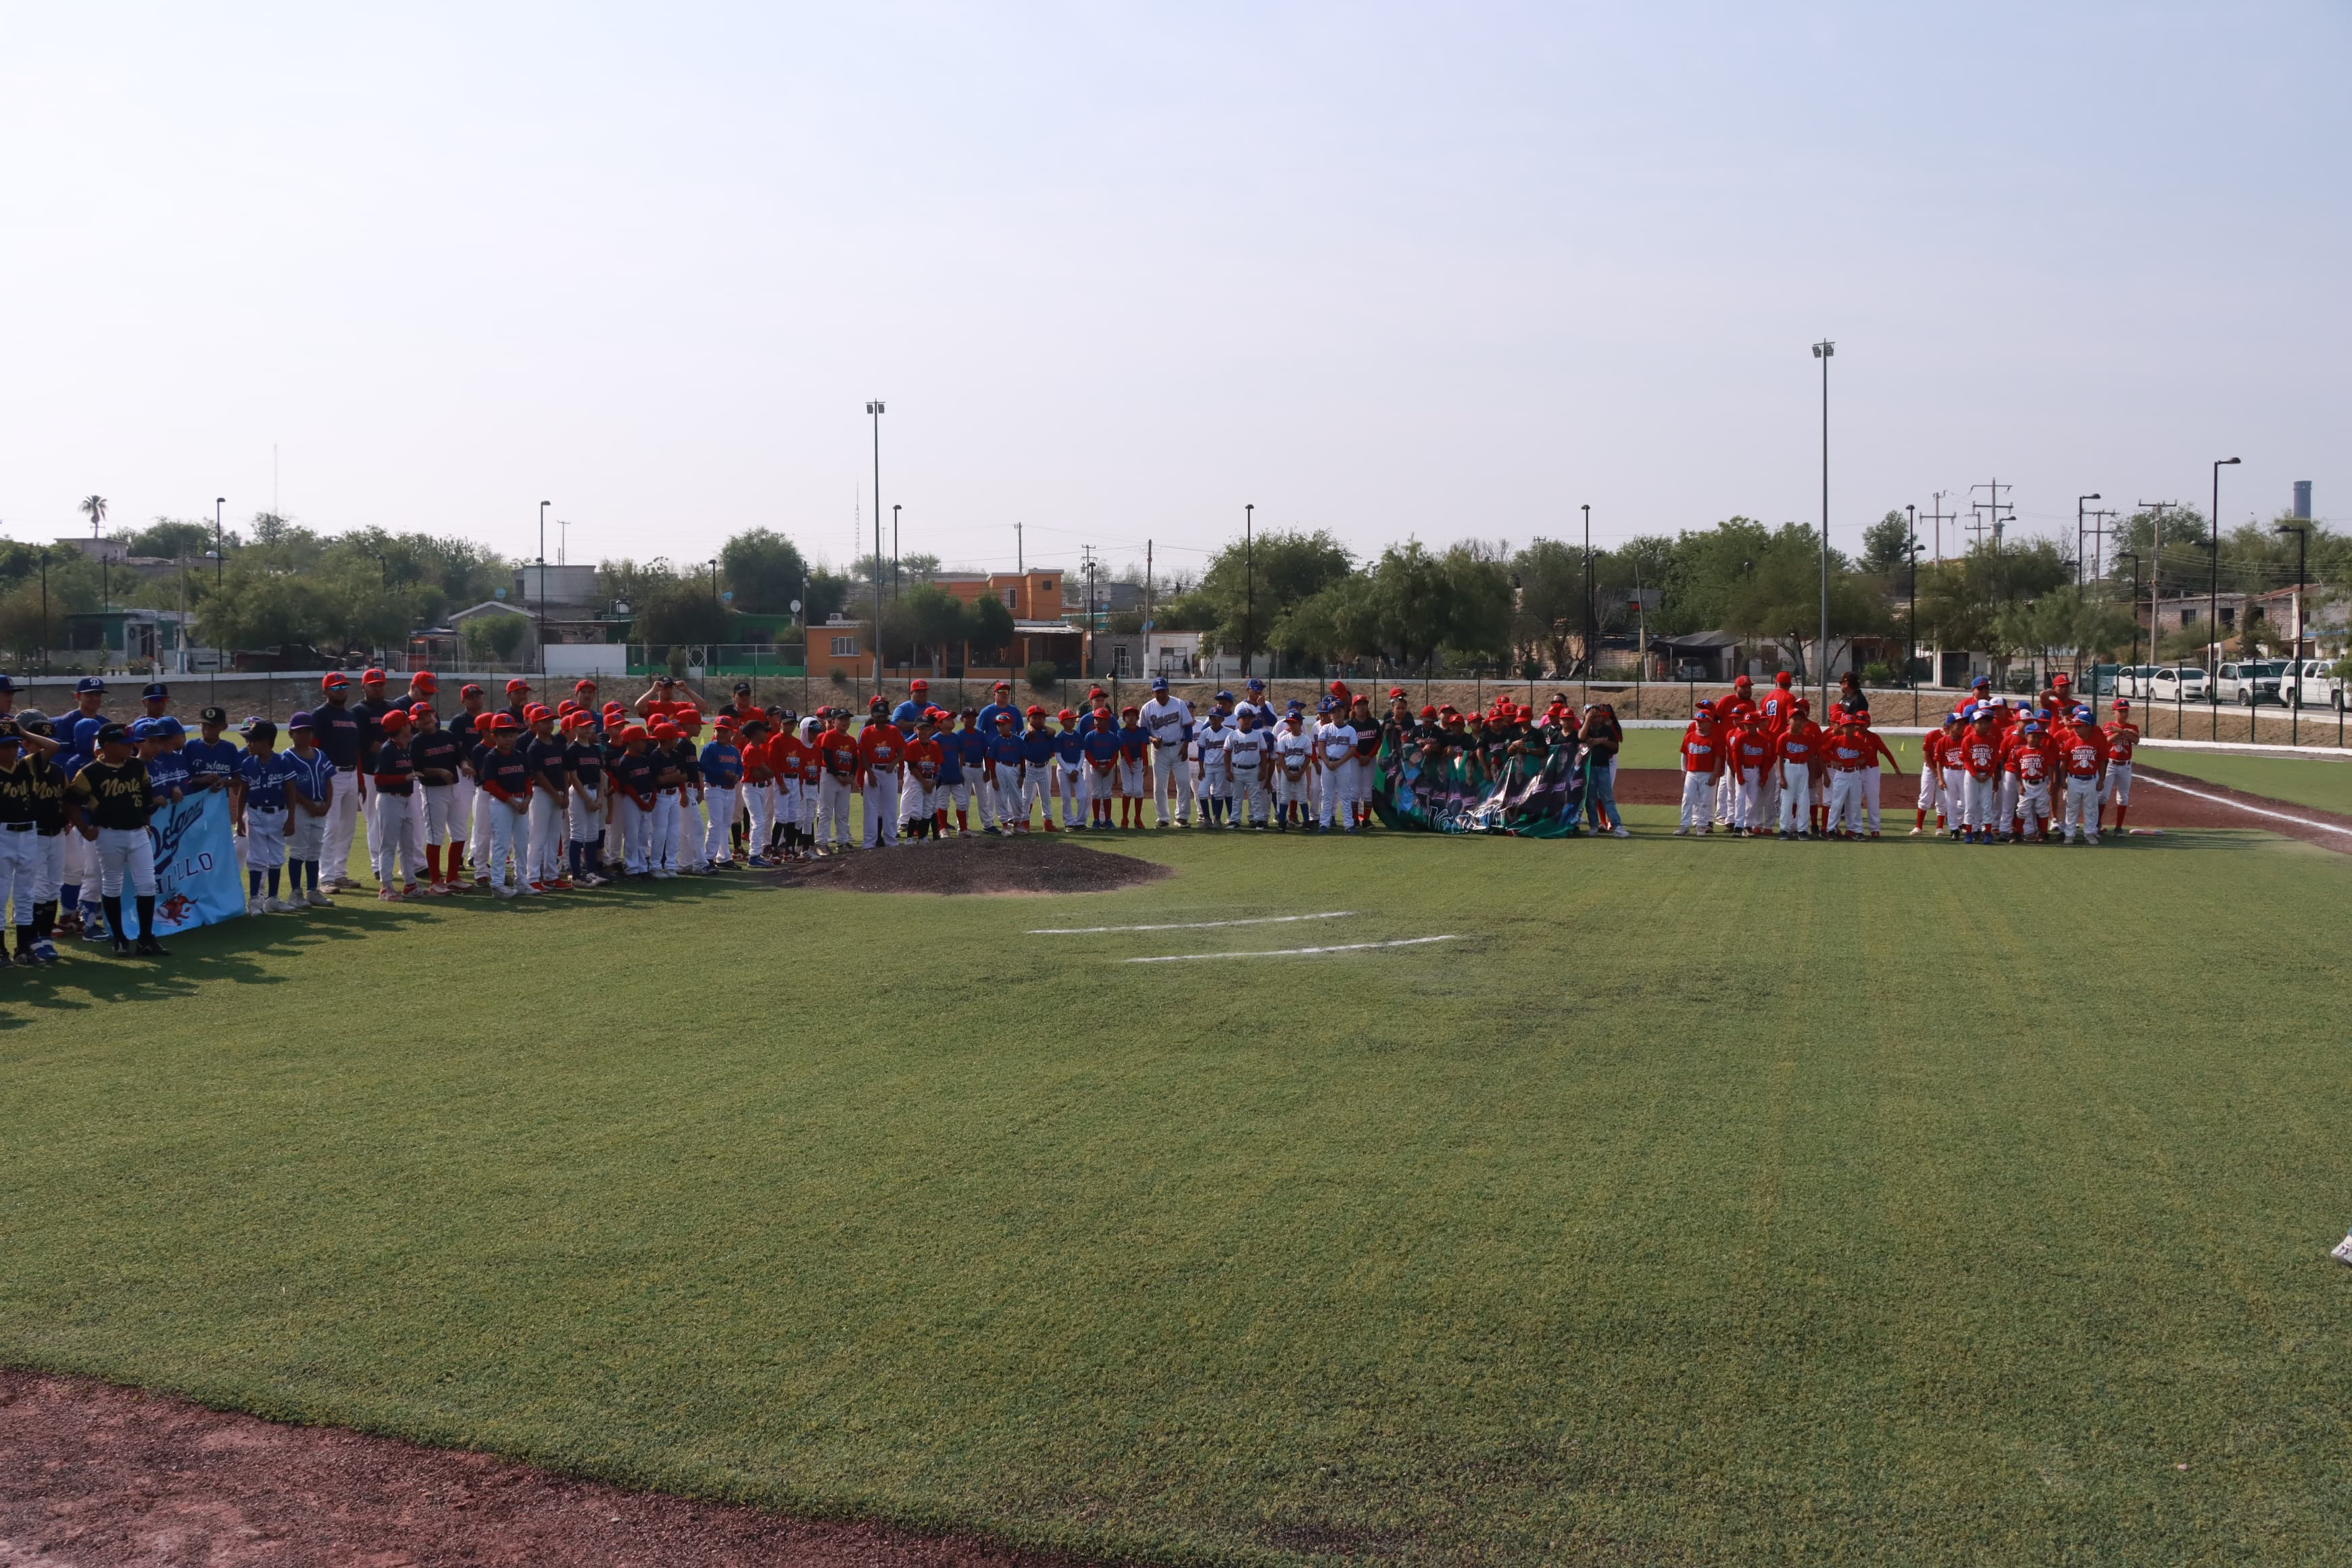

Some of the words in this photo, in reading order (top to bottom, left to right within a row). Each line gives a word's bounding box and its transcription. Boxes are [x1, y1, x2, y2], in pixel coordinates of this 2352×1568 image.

[89, 678, 99, 686] D
[1, 724, 13, 735] R
[43, 725, 52, 735] R
[100, 778, 141, 797] Norte
